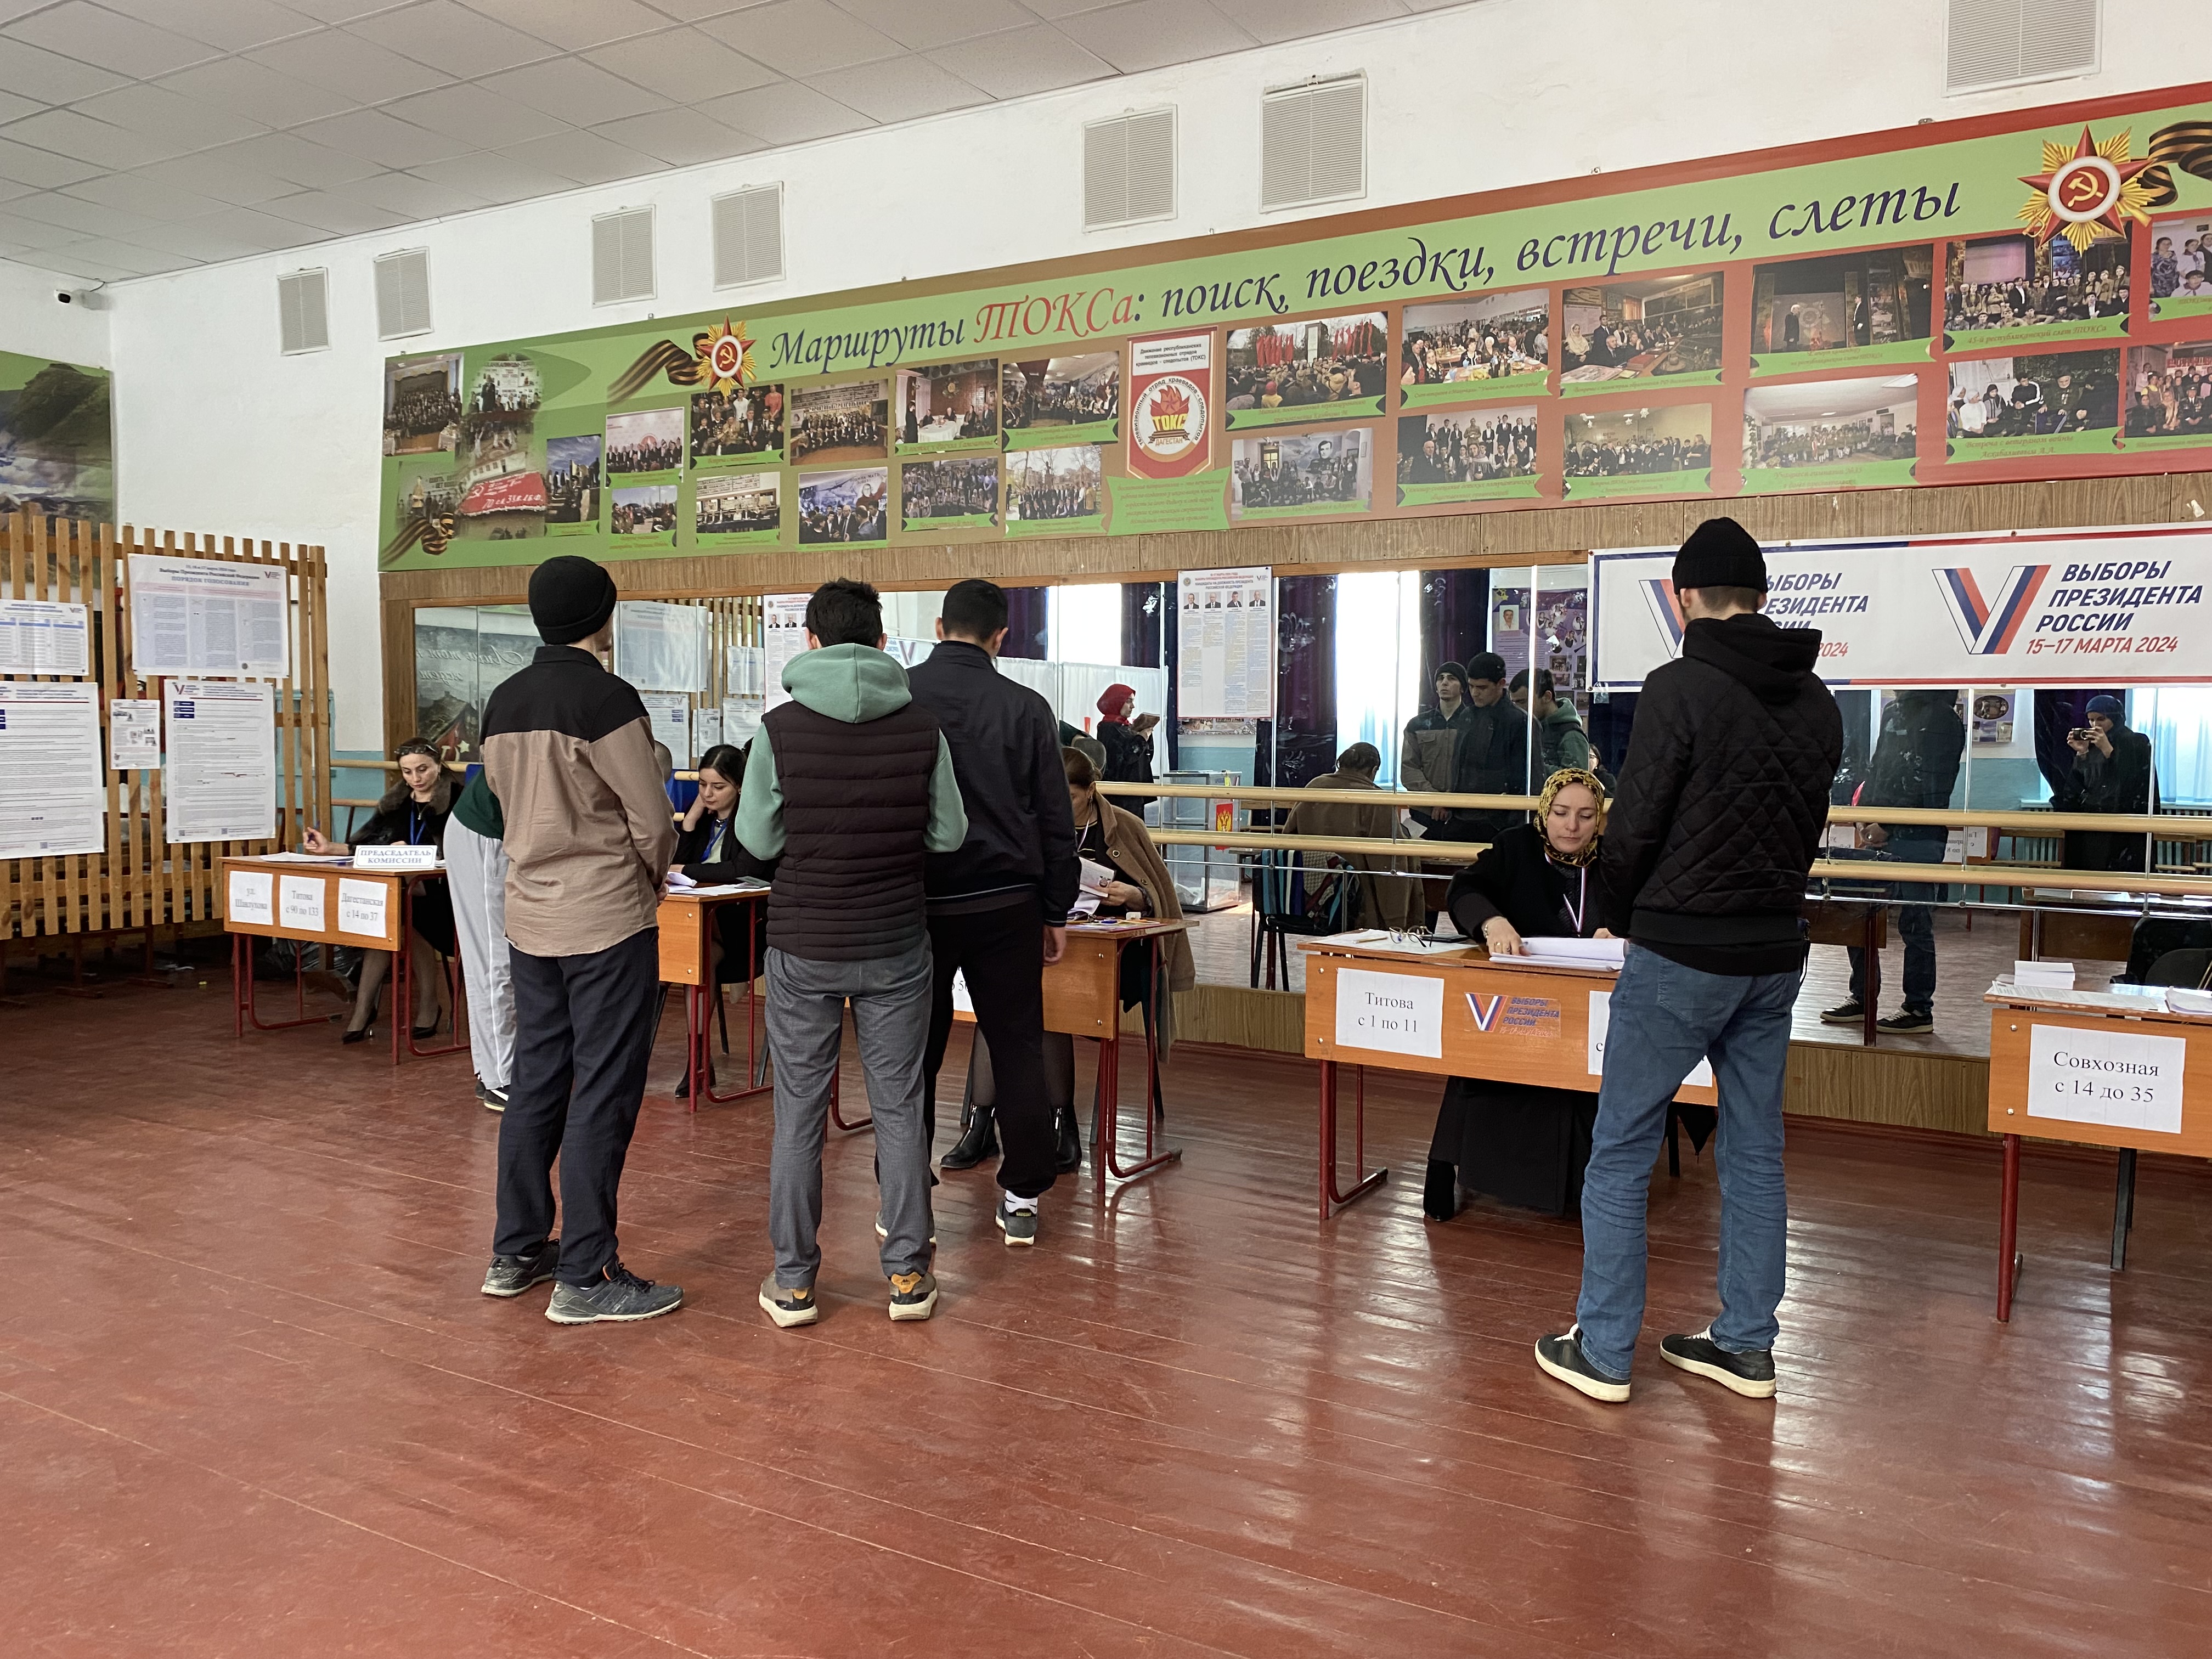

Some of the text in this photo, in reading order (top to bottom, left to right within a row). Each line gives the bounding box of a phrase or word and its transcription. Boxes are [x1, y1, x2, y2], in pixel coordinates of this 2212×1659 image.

[769, 182, 1960, 374] Маршруты ТОКСа: поиск, поездки, встречи, слеты
[1134, 393, 1147, 446] телевизионный
[1149, 379, 1166, 392] отряд
[1169, 377, 1198, 394] краеведов
[1195, 398, 1205, 441] следопытов
[1152, 413, 1188, 432] ТОКС
[1155, 437, 1183, 447] ДАГЕСТАН
[2061, 560, 2172, 583] ВЫБОРЫ
[1767, 573, 1842, 591] ЫБОРЫ
[1764, 595, 1869, 616] ЕЗИДЕНТА
[2048, 585, 2203, 608] ПРЕЗИДЕНТА
[2035, 613, 2135, 633] РОССИИ
[2074, 637, 2133, 654] МАРТА
[2135, 636, 2179, 653] 2024
[291, 890, 313, 900] Титова
[341, 893, 383, 906] Дагестанская
[290, 905, 298, 913] 90
[308, 907, 319, 916] 133
[352, 910, 359, 918] 14
[370, 912, 379, 921] 37
[1365, 992, 1414, 1010] Титова
[1511, 997, 1548, 1007] ВЫБОРЫ
[1503, 1017, 1536, 1026] РОССИИ
[1507, 1007, 1559, 1019] ПРЕЗИДЕНТА
[1358, 1013, 1418, 1032] с 1 по 11
[2053, 1051, 2159, 1076] Совхозная
[2055, 1080, 2153, 1103] с 14 до 35
